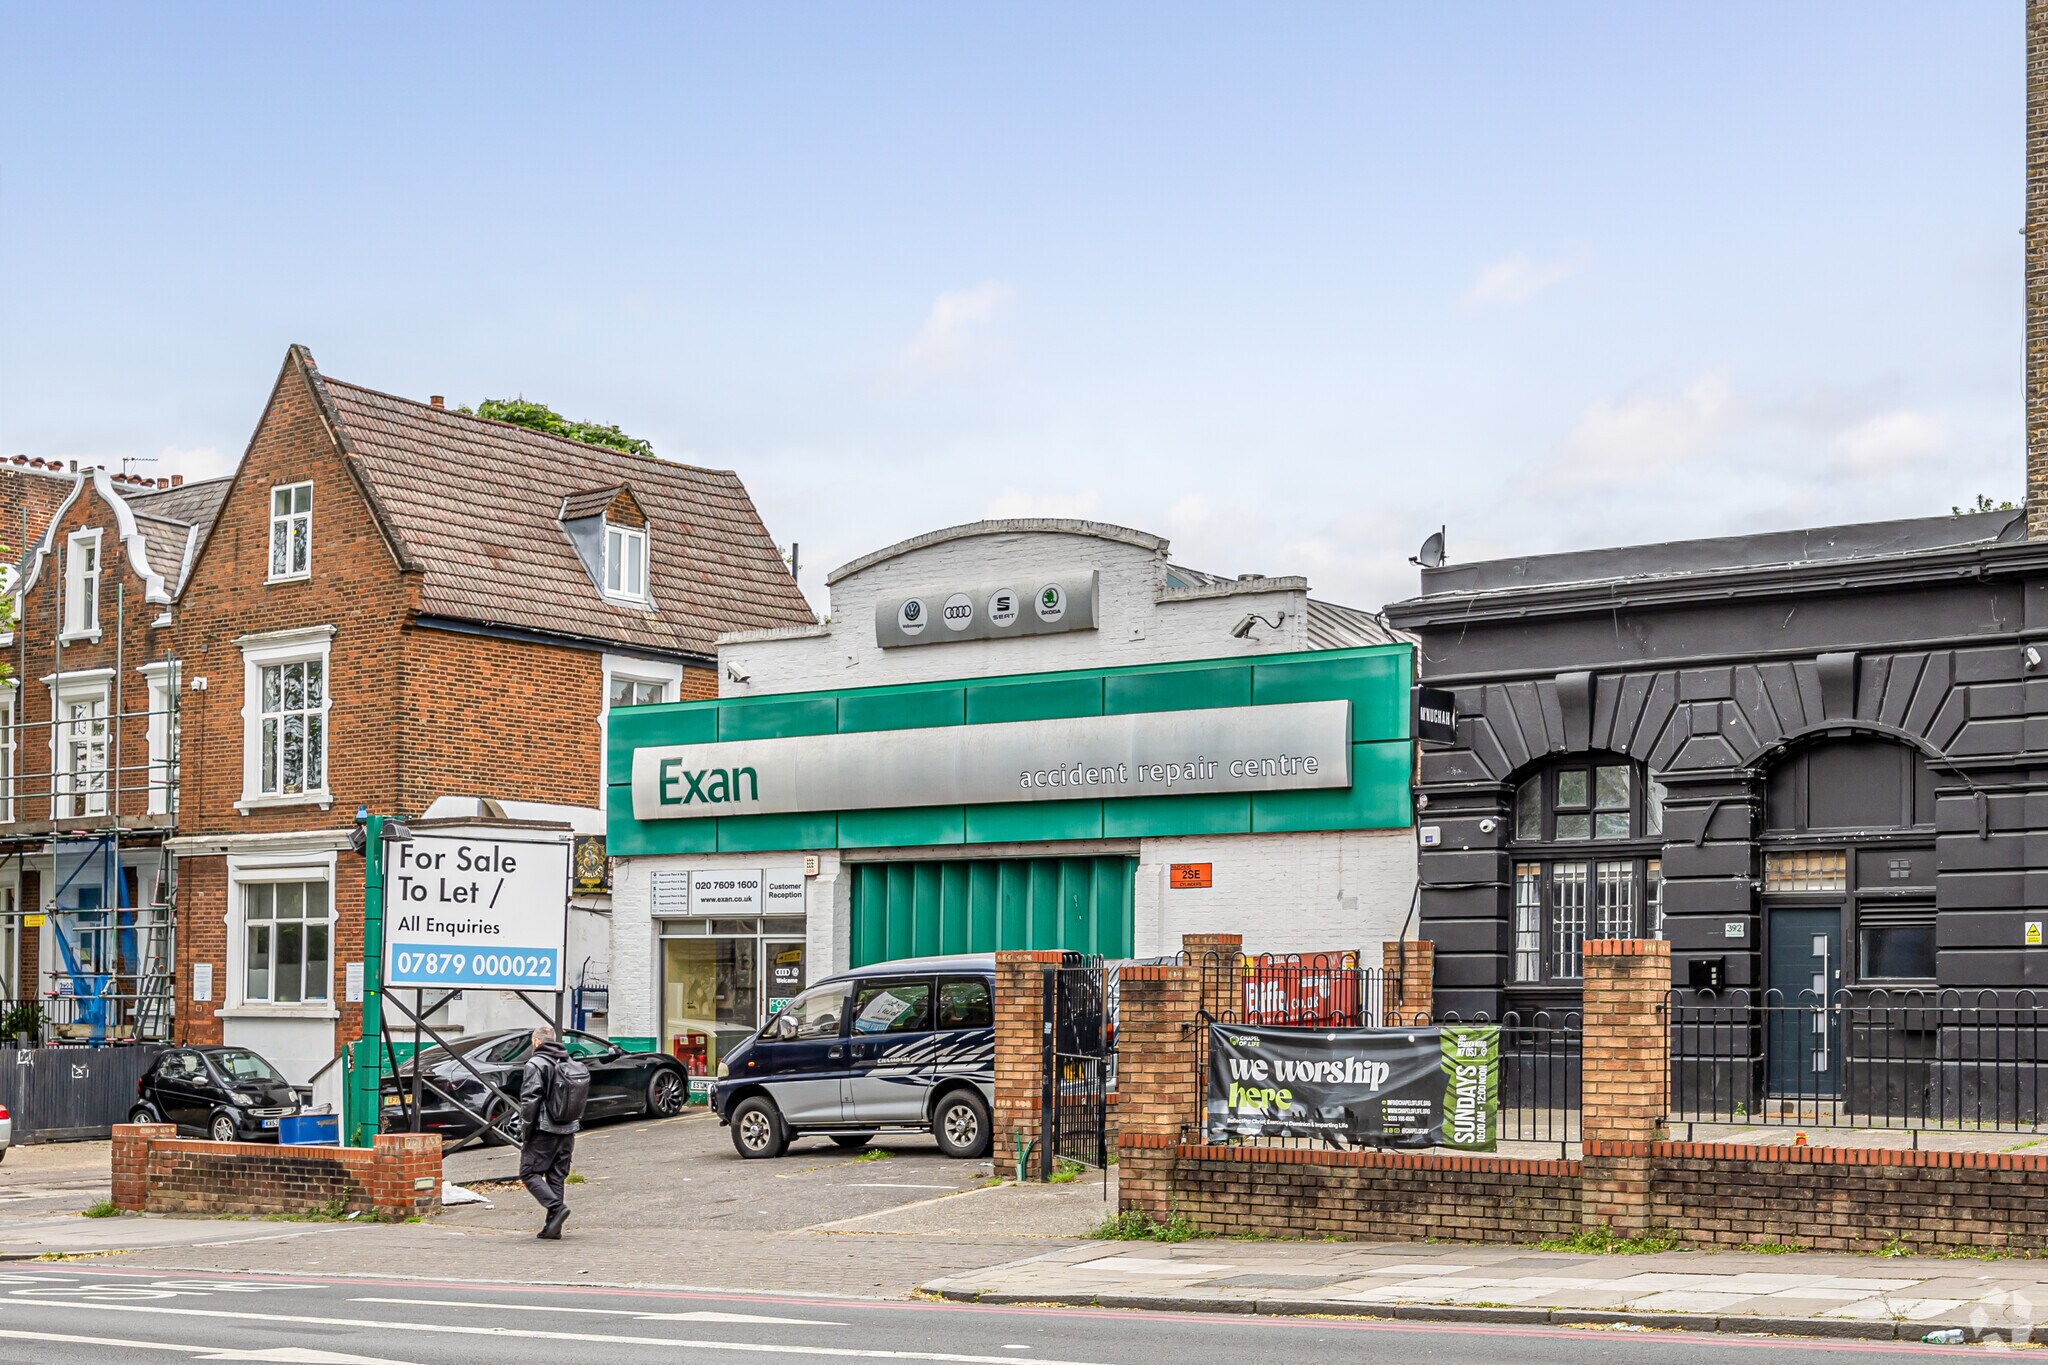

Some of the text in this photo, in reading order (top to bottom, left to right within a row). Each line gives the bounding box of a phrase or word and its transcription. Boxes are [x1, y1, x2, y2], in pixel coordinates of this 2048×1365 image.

[1019, 753, 1318, 788] accident repair centre
[659, 757, 759, 806] Exan
[400, 844, 517, 873] For Sale
[695, 880, 758, 890] 020 7609 1600
[1182, 869, 1200, 880] 2SE
[398, 876, 427, 902] To
[439, 878, 479, 903] Let
[769, 891, 802, 900] Reception
[398, 916, 500, 937] All Enquiries
[1727, 924, 1742, 932] 392
[397, 952, 552, 977] 07879 000022
[1229, 1056, 1390, 1092] we worship
[1478, 1065, 1488, 1084] NOON
[1228, 1081, 1293, 1111] here
[1454, 1065, 1478, 1144] SUNDAYS
[1478, 1086, 1487, 1104] 12:00
[1478, 1110, 1486, 1123] AM
[1476, 1124, 1486, 1143] 10:00
